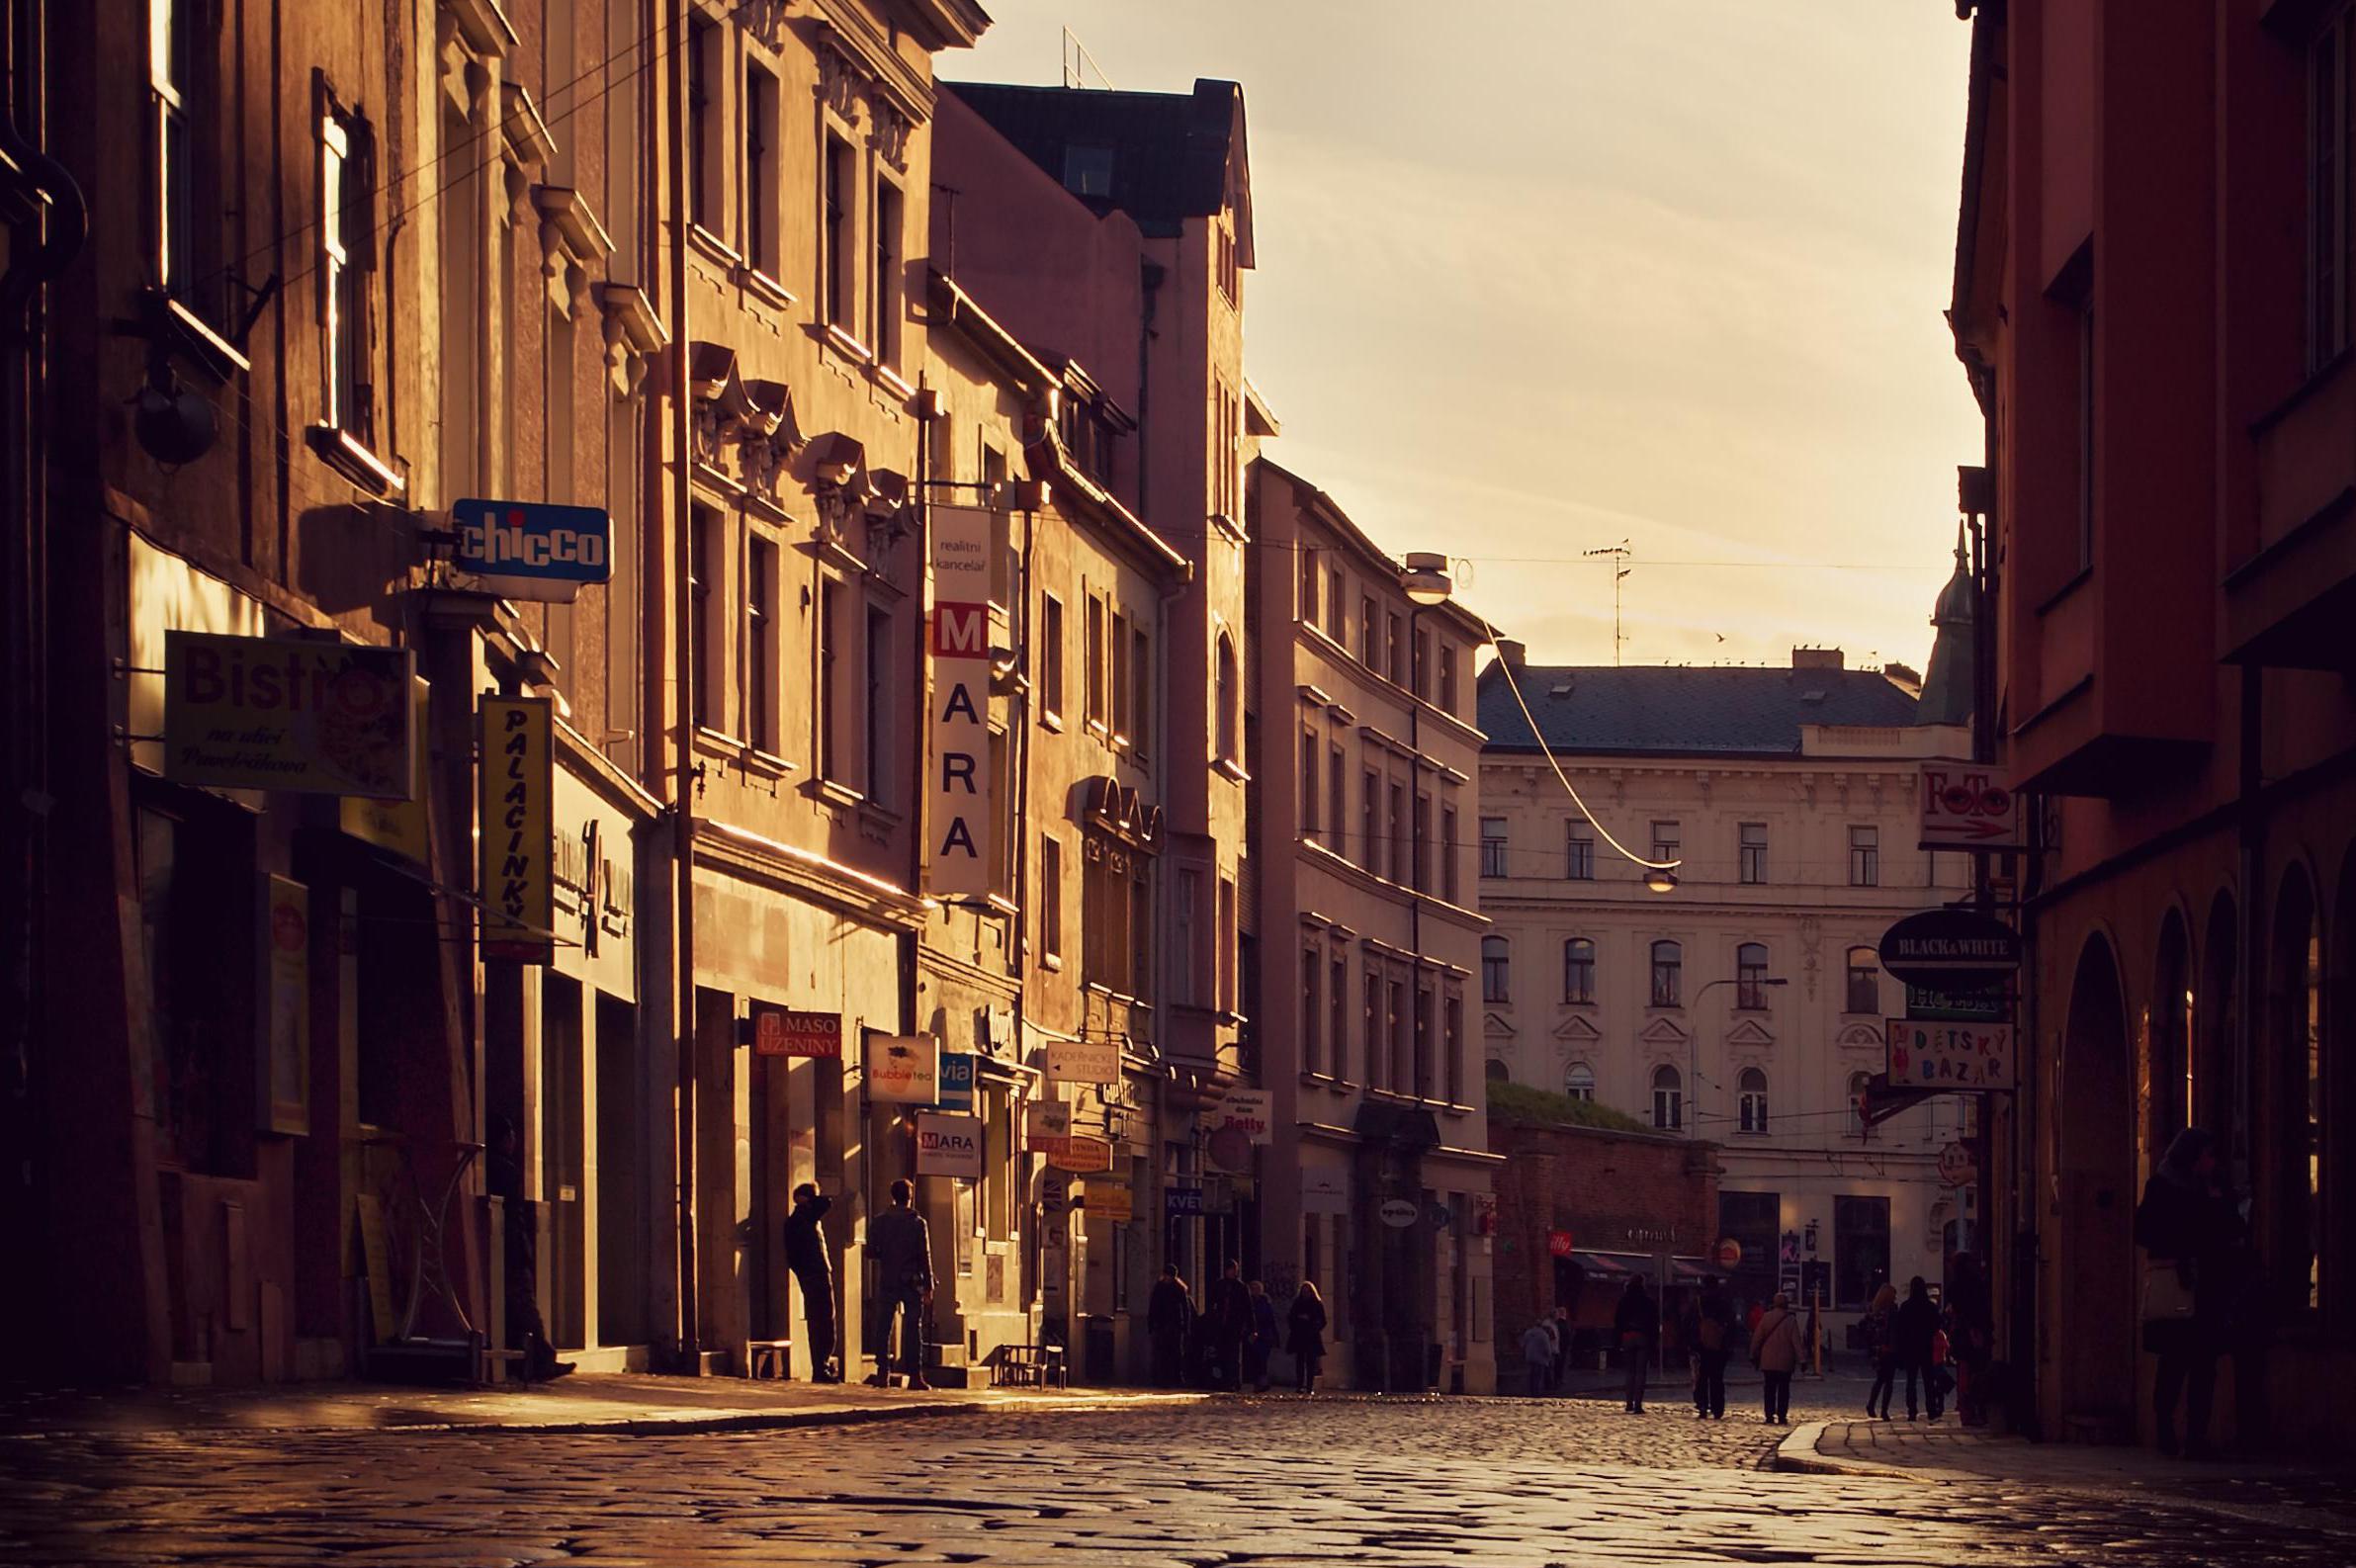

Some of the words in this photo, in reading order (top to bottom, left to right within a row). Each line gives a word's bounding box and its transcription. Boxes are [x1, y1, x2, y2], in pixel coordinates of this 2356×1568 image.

[461, 506, 604, 566] chicco
[940, 608, 981, 858] MARA
[786, 1017, 836, 1034] MASO
[761, 1035, 837, 1055] UZENINY
[1076, 1063, 1114, 1076] STUDIO
[922, 1133, 974, 1149] MARA
